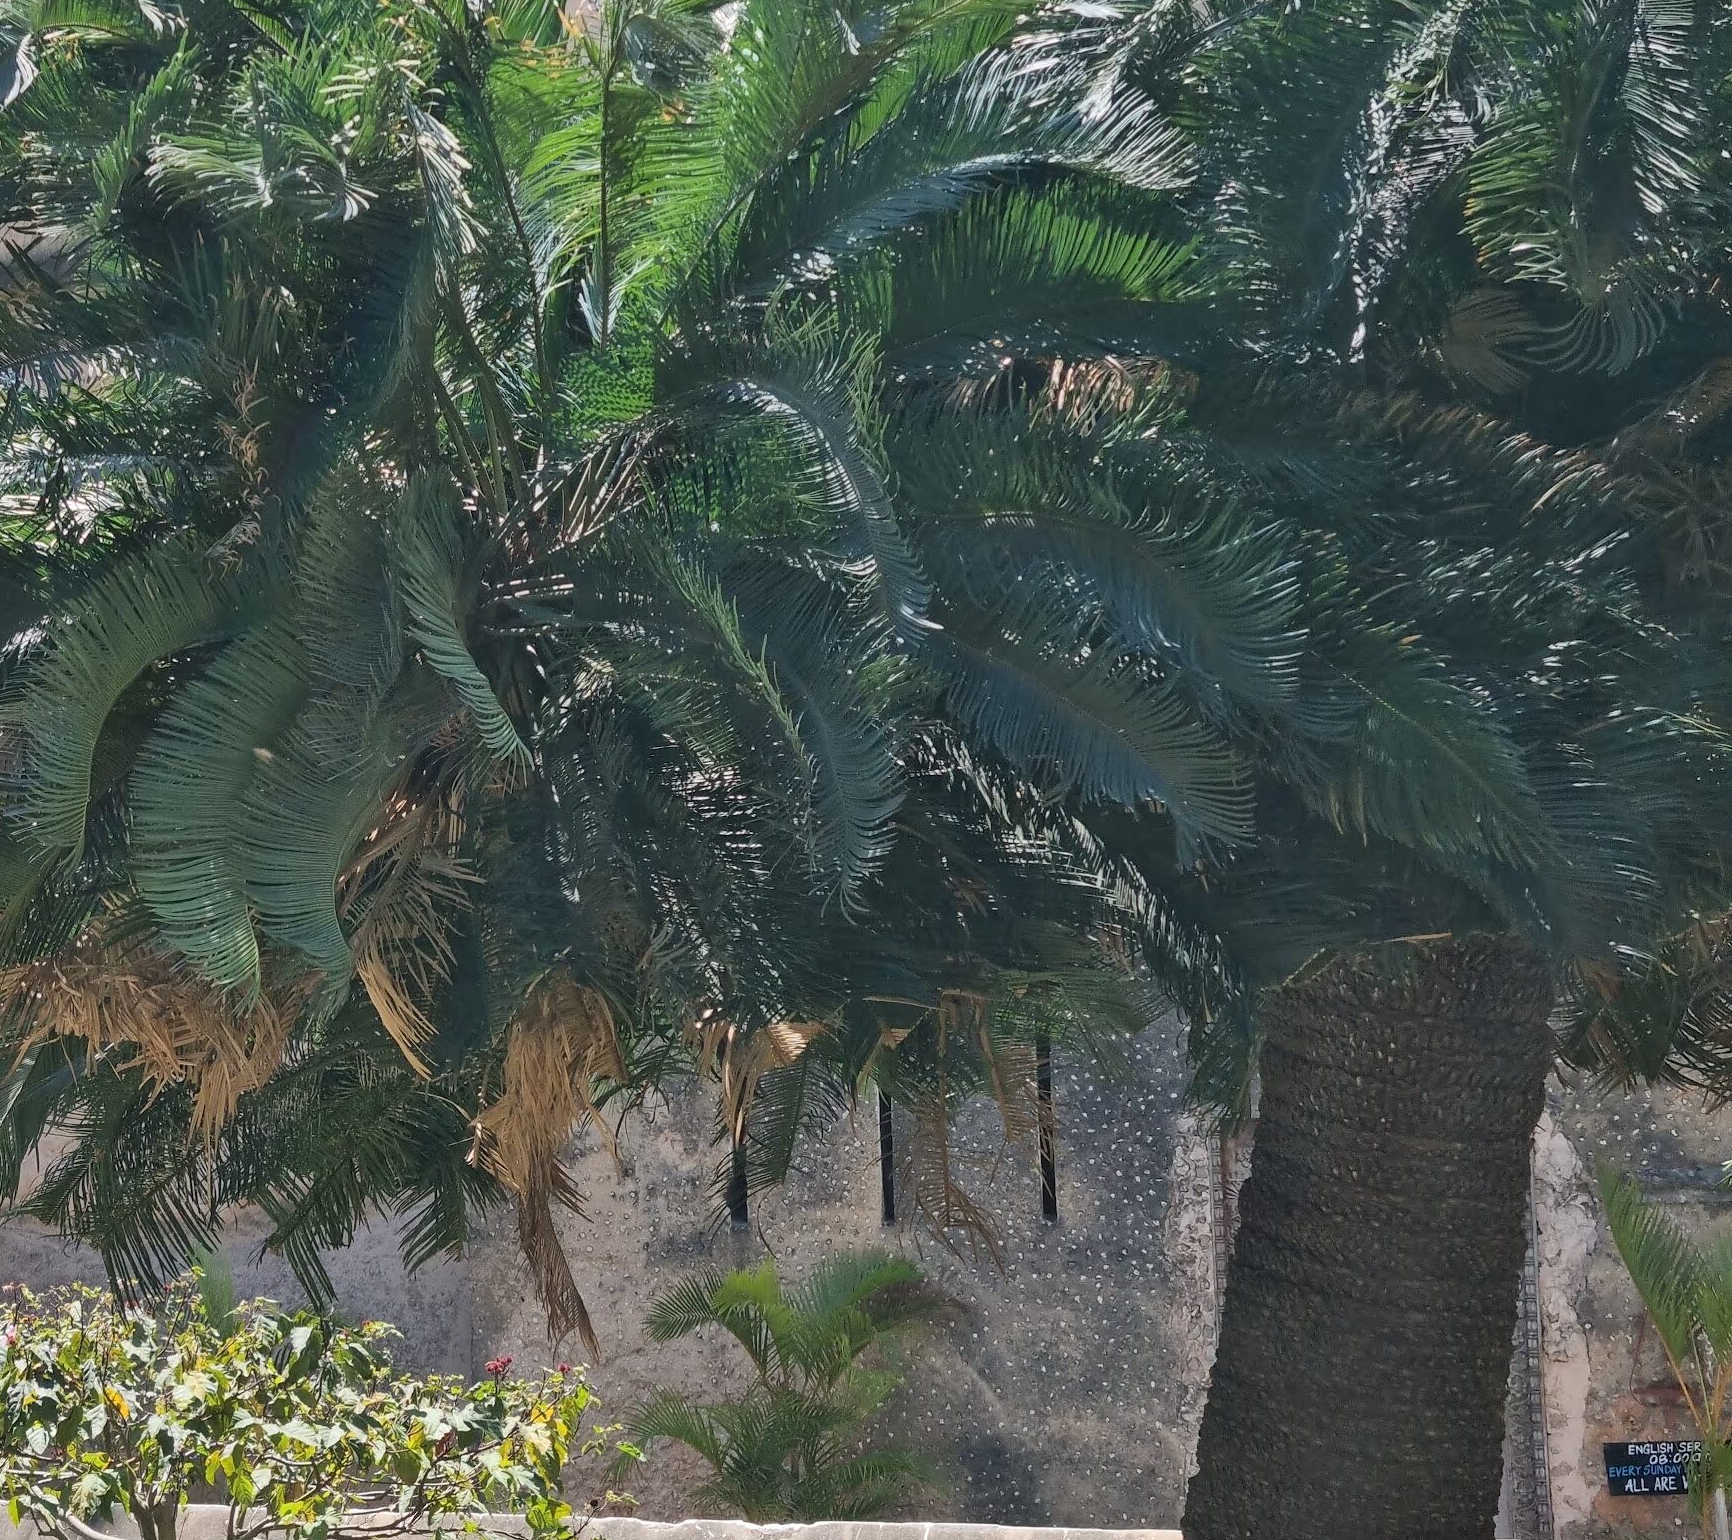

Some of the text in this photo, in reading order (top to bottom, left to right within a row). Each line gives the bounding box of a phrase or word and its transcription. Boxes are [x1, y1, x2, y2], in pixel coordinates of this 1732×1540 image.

[1628, 1441, 1702, 1455] ENGLISH SER
[1609, 1464, 1682, 1478] EVERY SUNDAY
[1625, 1478, 1650, 1493] ALL
[1654, 1476, 1678, 1491] ARE
